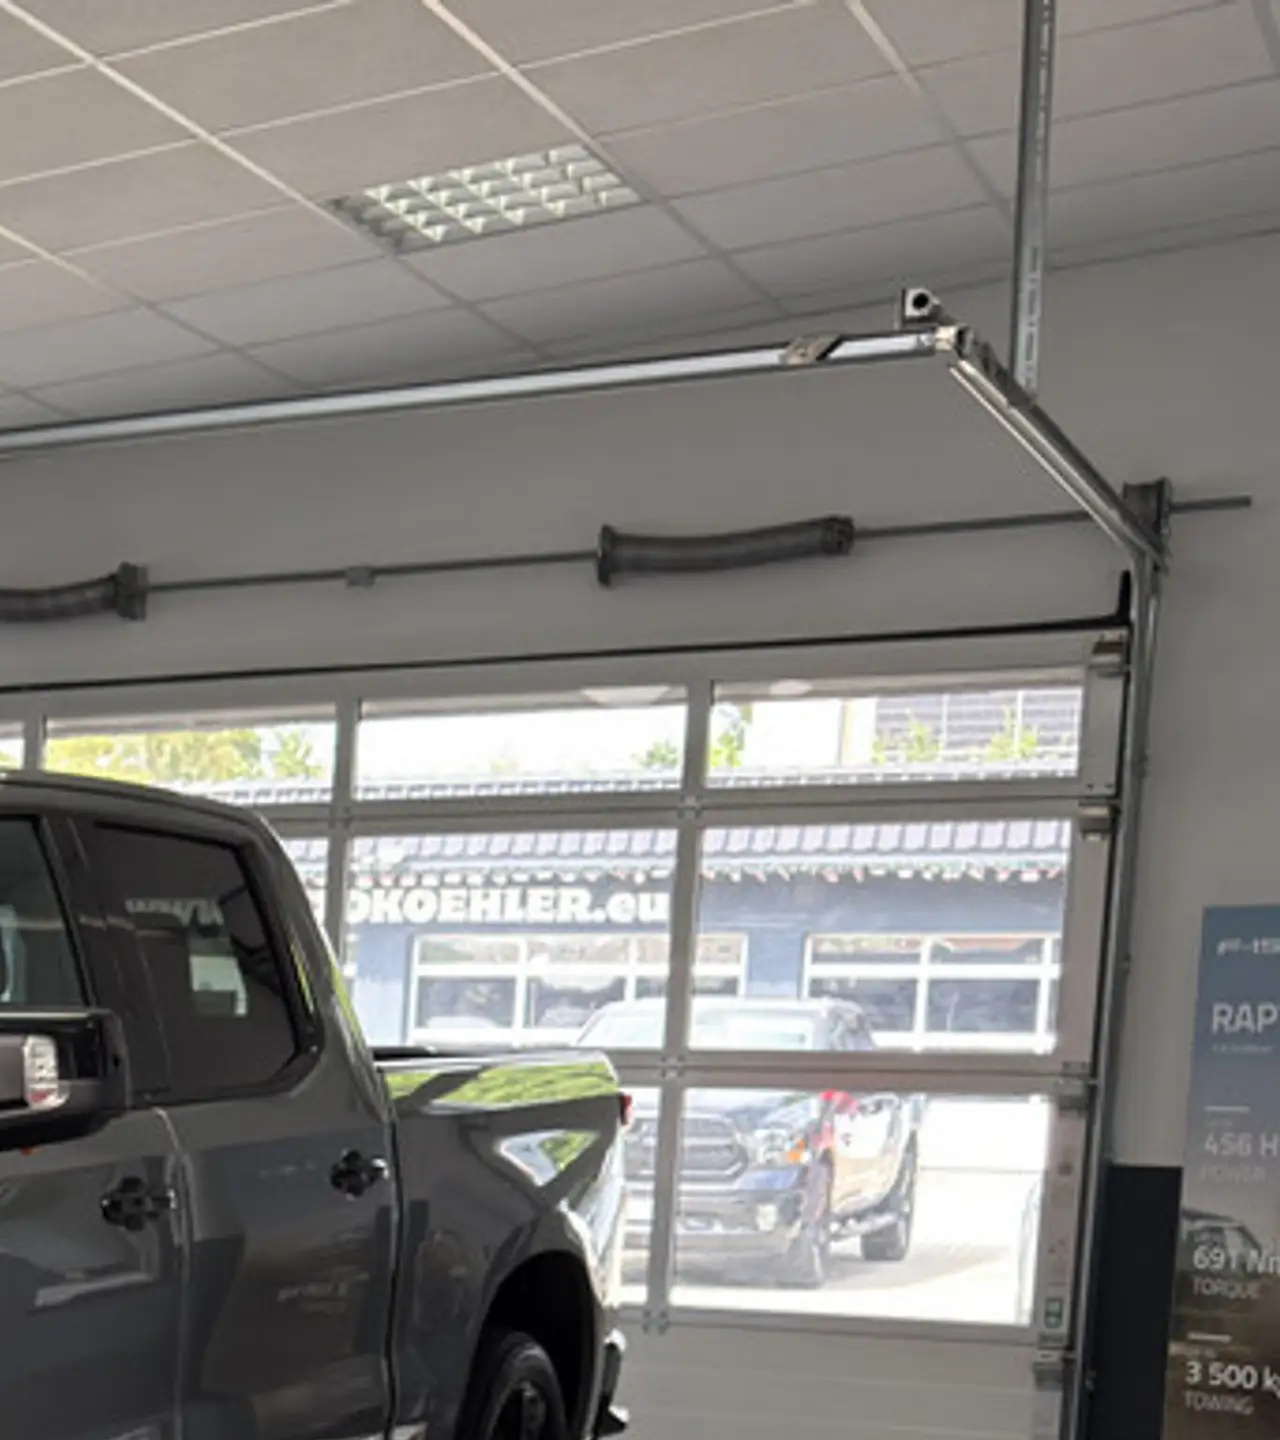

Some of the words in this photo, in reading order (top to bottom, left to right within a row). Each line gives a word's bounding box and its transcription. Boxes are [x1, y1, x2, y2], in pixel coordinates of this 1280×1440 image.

[1211, 1001, 1280, 1035] RAP
[1185, 1360, 1203, 1386] 3
[1208, 1361, 1259, 1391] 500
